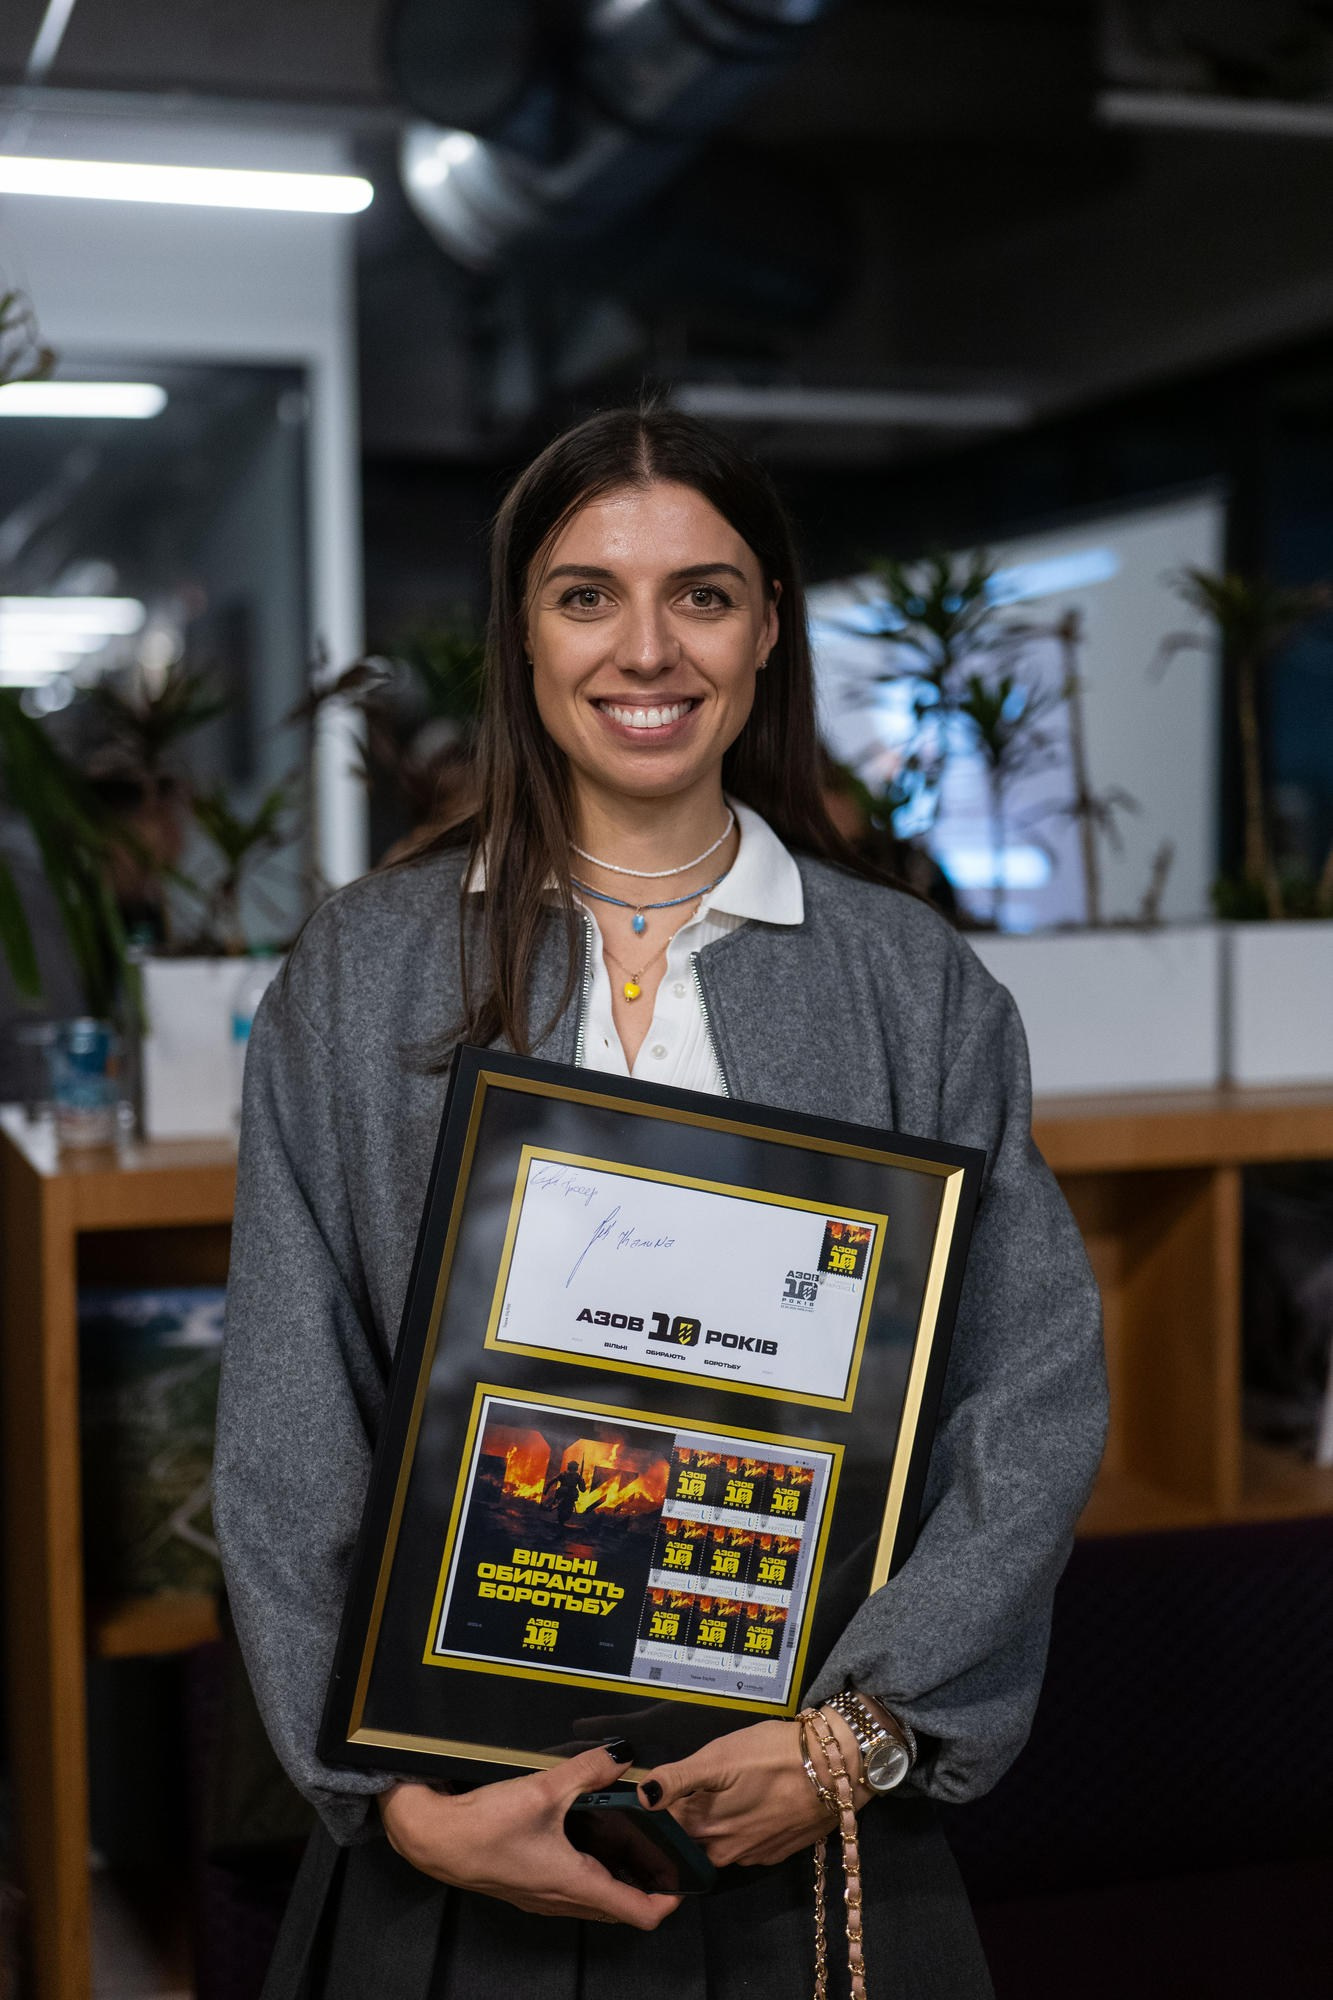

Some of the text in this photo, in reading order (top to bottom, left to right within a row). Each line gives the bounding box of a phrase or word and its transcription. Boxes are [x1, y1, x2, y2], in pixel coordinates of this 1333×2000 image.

[832, 1245, 858, 1255] АЗОВ
[828, 1252, 856, 1270] 10
[787, 1270, 819, 1281] АЗОВ
[783, 1279, 818, 1301] 10
[782, 1297, 814, 1307] РОКІВ
[576, 1308, 778, 1356] АЗОВ 10 РОКІВ
[604, 1342, 741, 1370] ВІЛЬНІ ОБИРАЮТЬ БОРОТЬБУ
[680, 1471, 707, 1480] АЗОВ
[727, 1479, 755, 1489] АЗОВ
[677, 1478, 706, 1496] 10
[724, 1486, 753, 1504] 10
[774, 1487, 800, 1497] АЗОВ
[771, 1494, 799, 1512] 10
[667, 1541, 693, 1551] АЗОВ
[714, 1549, 741, 1558] АЗОВ
[512, 1548, 598, 1576] ВІЛЬНІ
[663, 1548, 692, 1567] 10
[711, 1556, 740, 1574] 10
[761, 1556, 787, 1565] АЗОВ
[477, 1562, 625, 1600] ОБИРАЮТЬ
[758, 1563, 787, 1581] 10
[478, 1581, 618, 1616] БОРОТЬБУ
[527, 1618, 560, 1628] АЗОВ
[653, 1611, 680, 1620] АЗОВ
[700, 1618, 727, 1628] АЗОВ
[523, 1625, 558, 1647] 10
[650, 1618, 679, 1636] 10
[697, 1625, 726, 1643] 10
[748, 1625, 774, 1635] АЗОВ
[744, 1632, 773, 1650] 10
